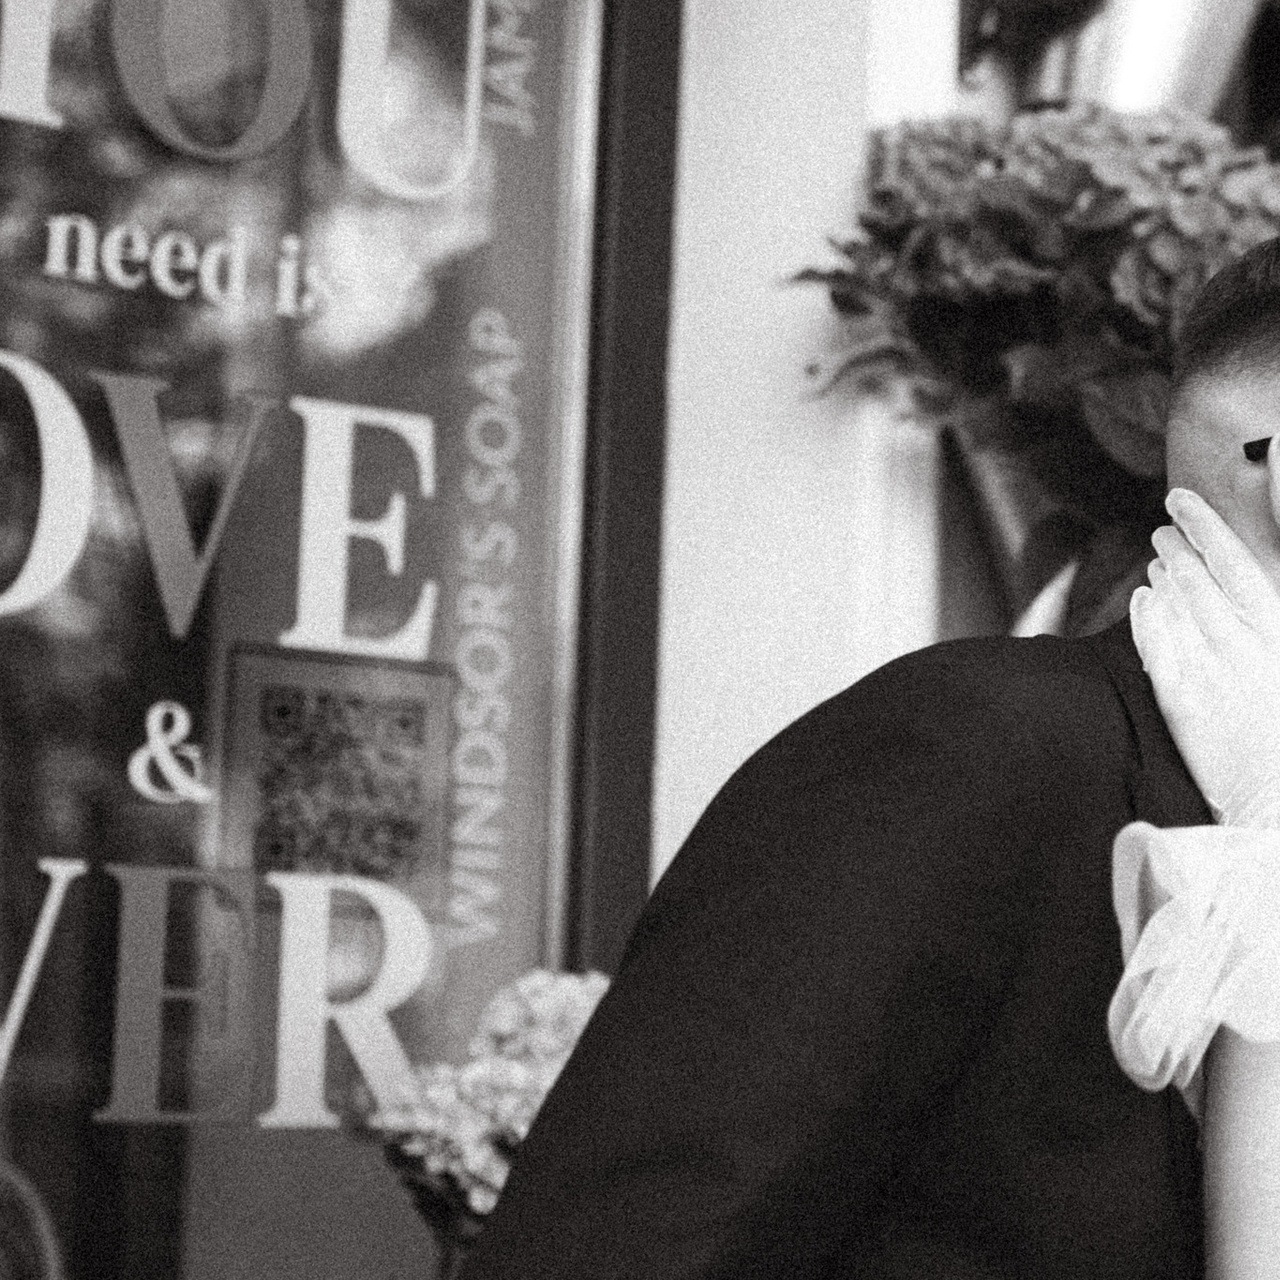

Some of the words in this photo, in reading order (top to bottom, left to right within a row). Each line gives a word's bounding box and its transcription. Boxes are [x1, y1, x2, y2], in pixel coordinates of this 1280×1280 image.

[44, 213, 248, 310] need
[463, 305, 522, 508] SOAP
[127, 700, 221, 804] &
